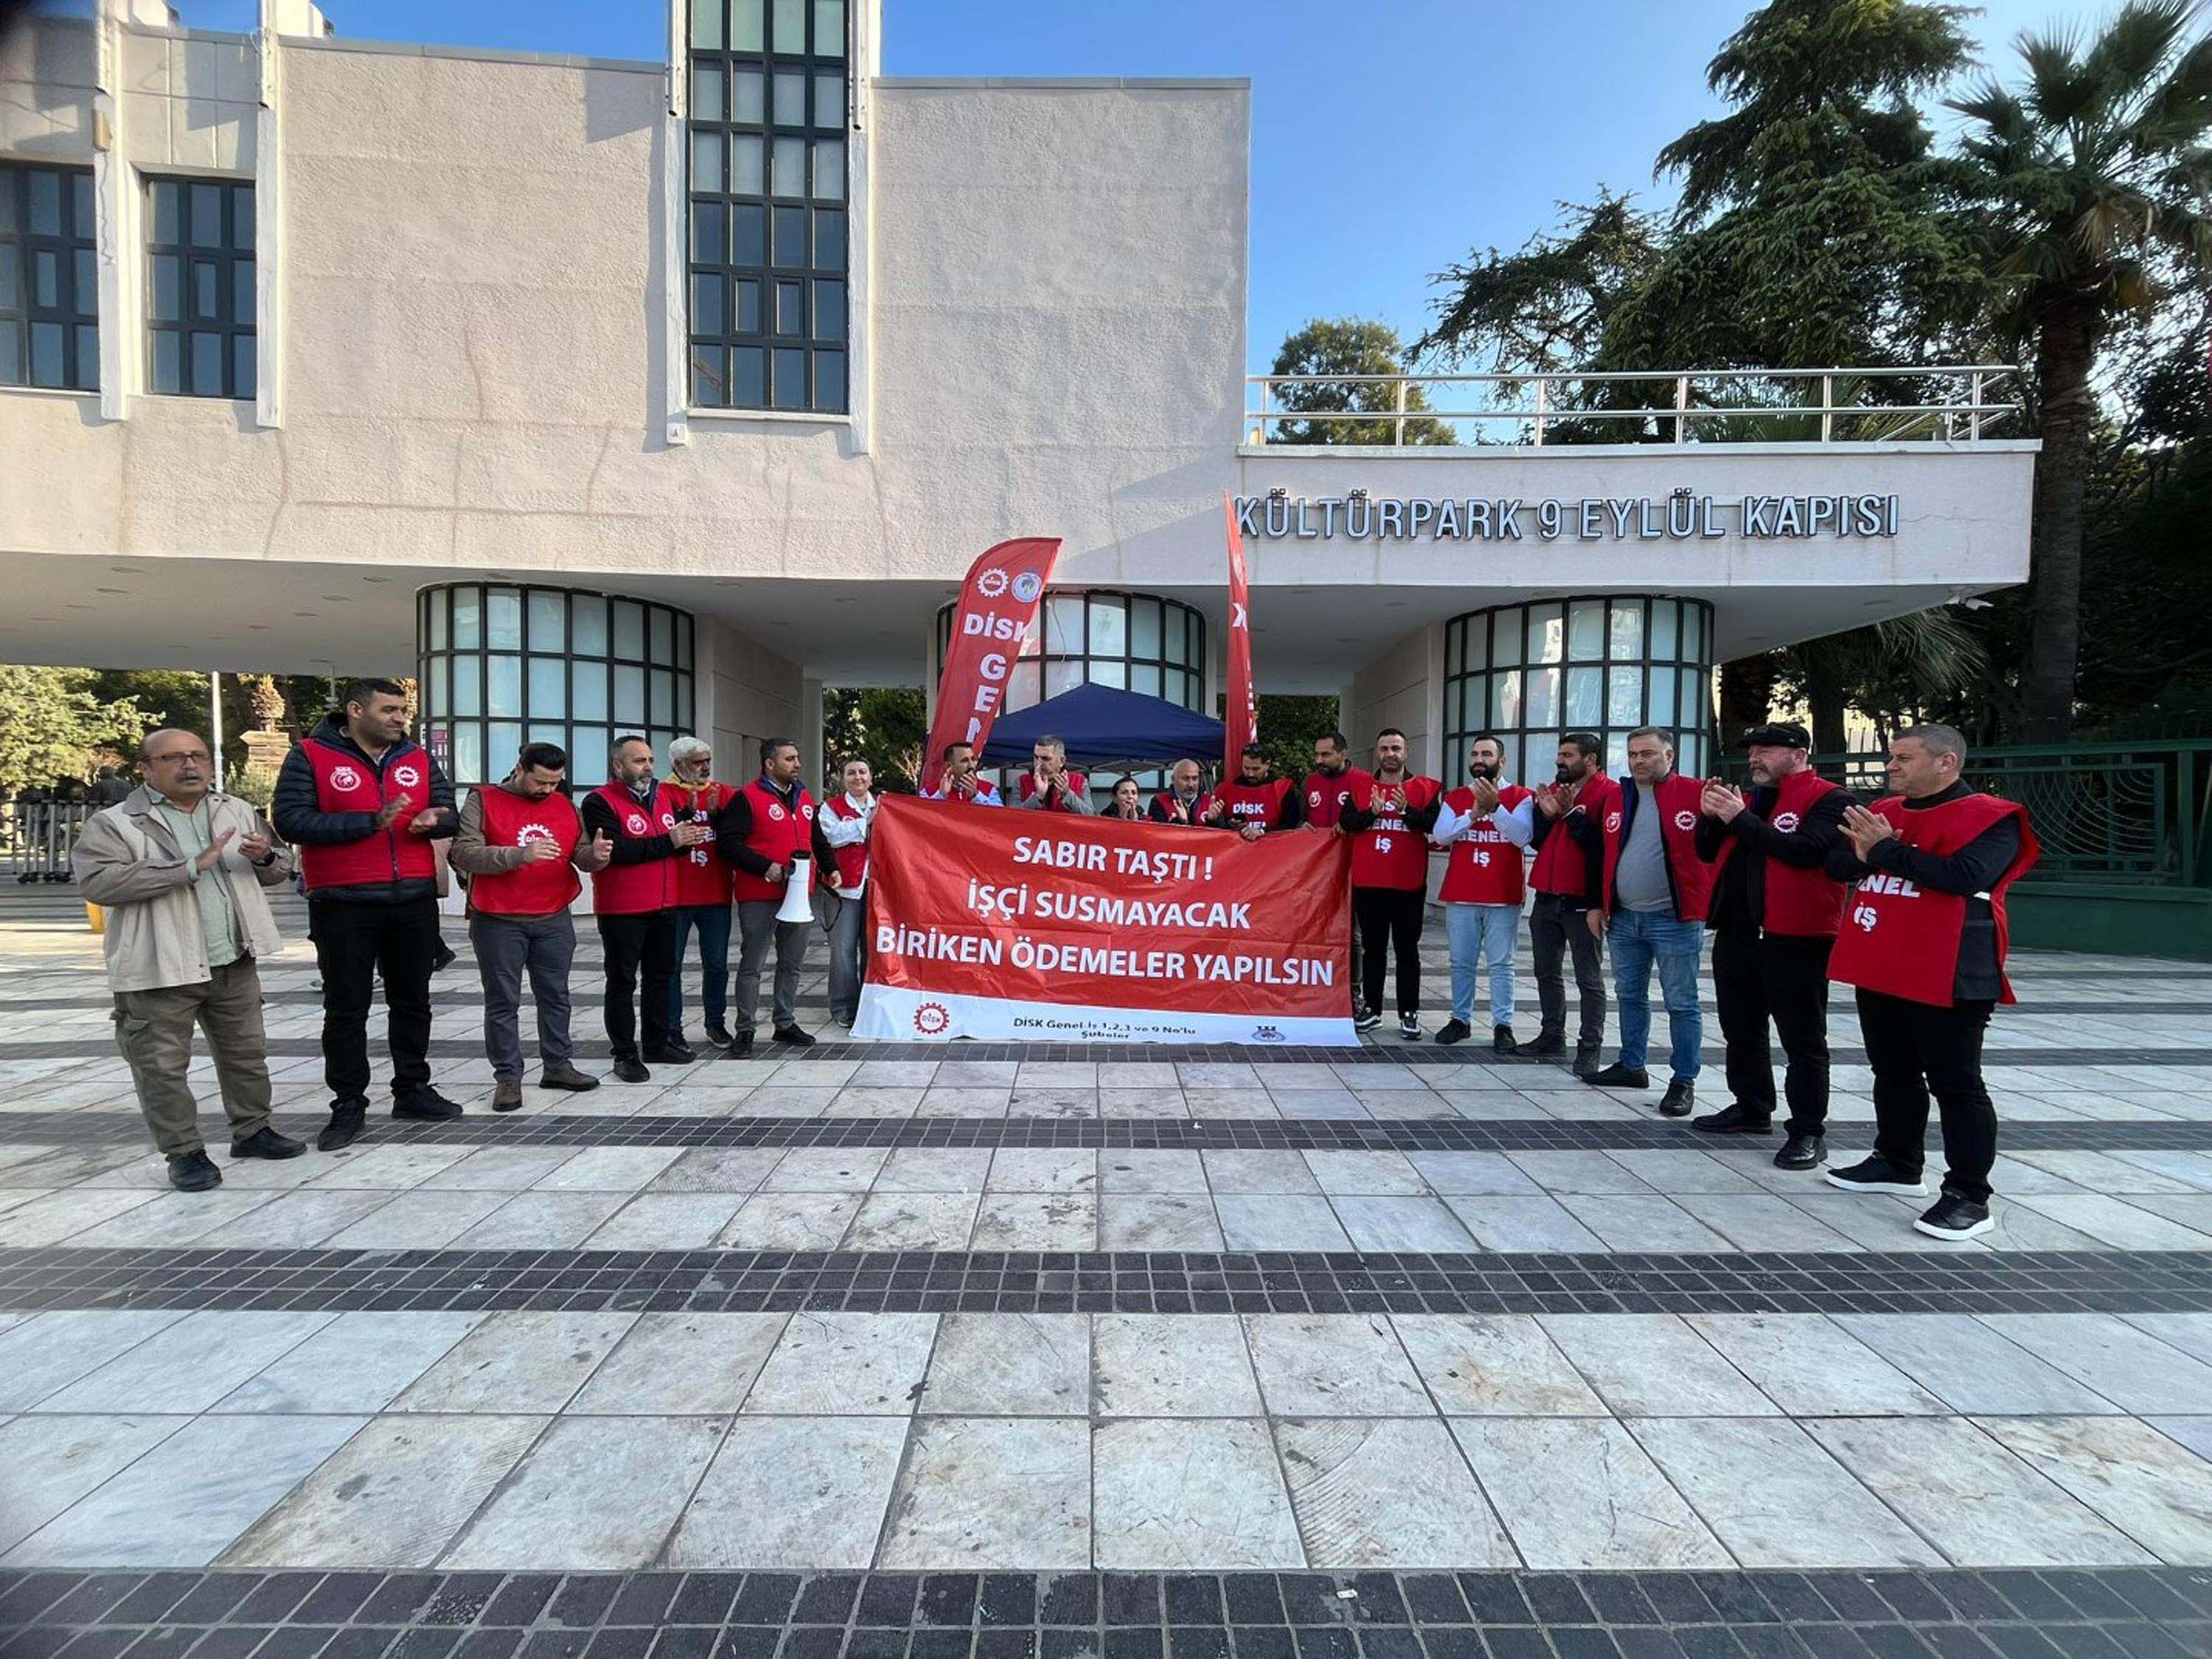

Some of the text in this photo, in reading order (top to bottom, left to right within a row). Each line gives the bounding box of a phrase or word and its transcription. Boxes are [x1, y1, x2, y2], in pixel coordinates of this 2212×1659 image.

[1234, 487, 1899, 540] KÜLTÜRPARK 9 EYLÜL KAPISI
[1233, 800, 1265, 814] DİSK
[690, 846, 708, 867] İŞ
[1374, 835, 1392, 853] İŞ
[1013, 836, 1213, 884] SABIR TAŞTI !
[1472, 848, 1490, 868] İŞ
[967, 877, 1251, 929] İŞÇİ SUSMAYACAK
[1854, 901, 1877, 932] İŞ
[876, 922, 1333, 987] BİRİKEN ÖDEMELER YAPILSIN
[1013, 1017, 1043, 1027] DİSK
